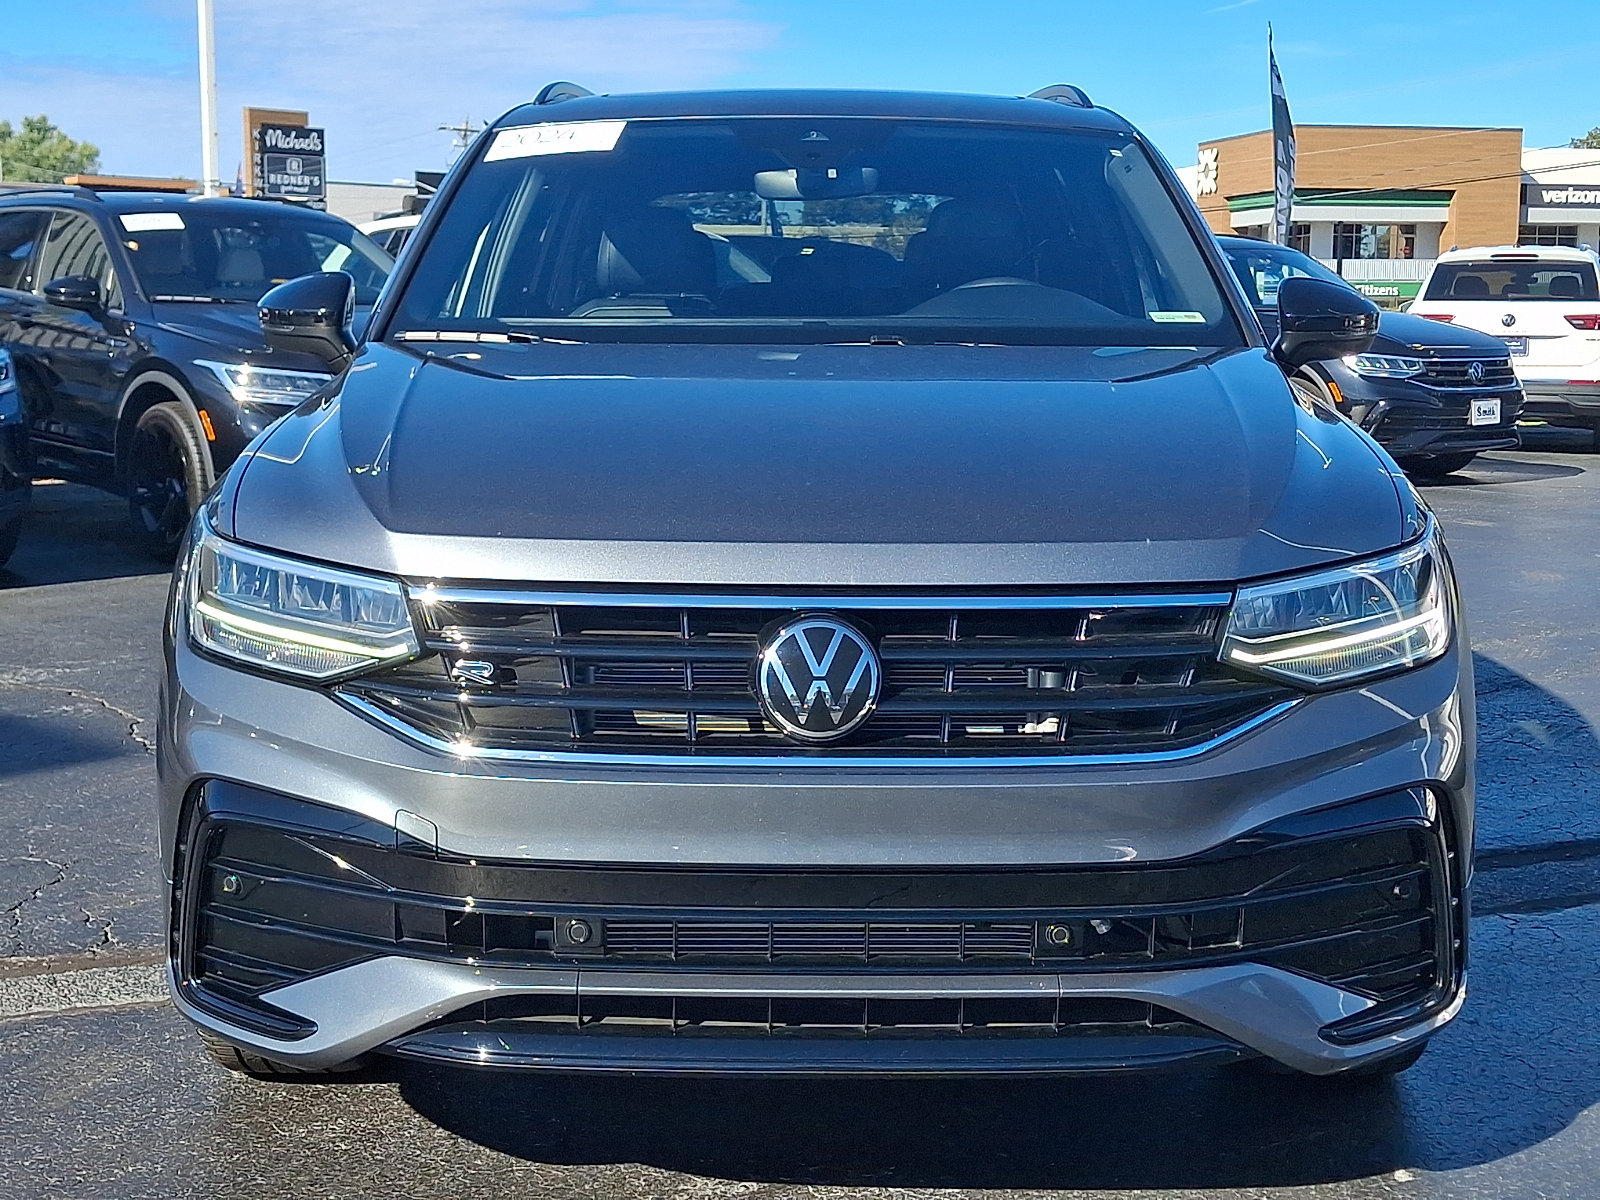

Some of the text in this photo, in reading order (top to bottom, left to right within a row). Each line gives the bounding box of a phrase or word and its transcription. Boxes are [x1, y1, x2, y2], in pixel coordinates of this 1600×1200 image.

[265, 128, 323, 151] Michaels
[268, 174, 321, 187] REDNER'S
[1541, 186, 1600, 204] verizon
[1476, 406, 1496, 417] Smith
